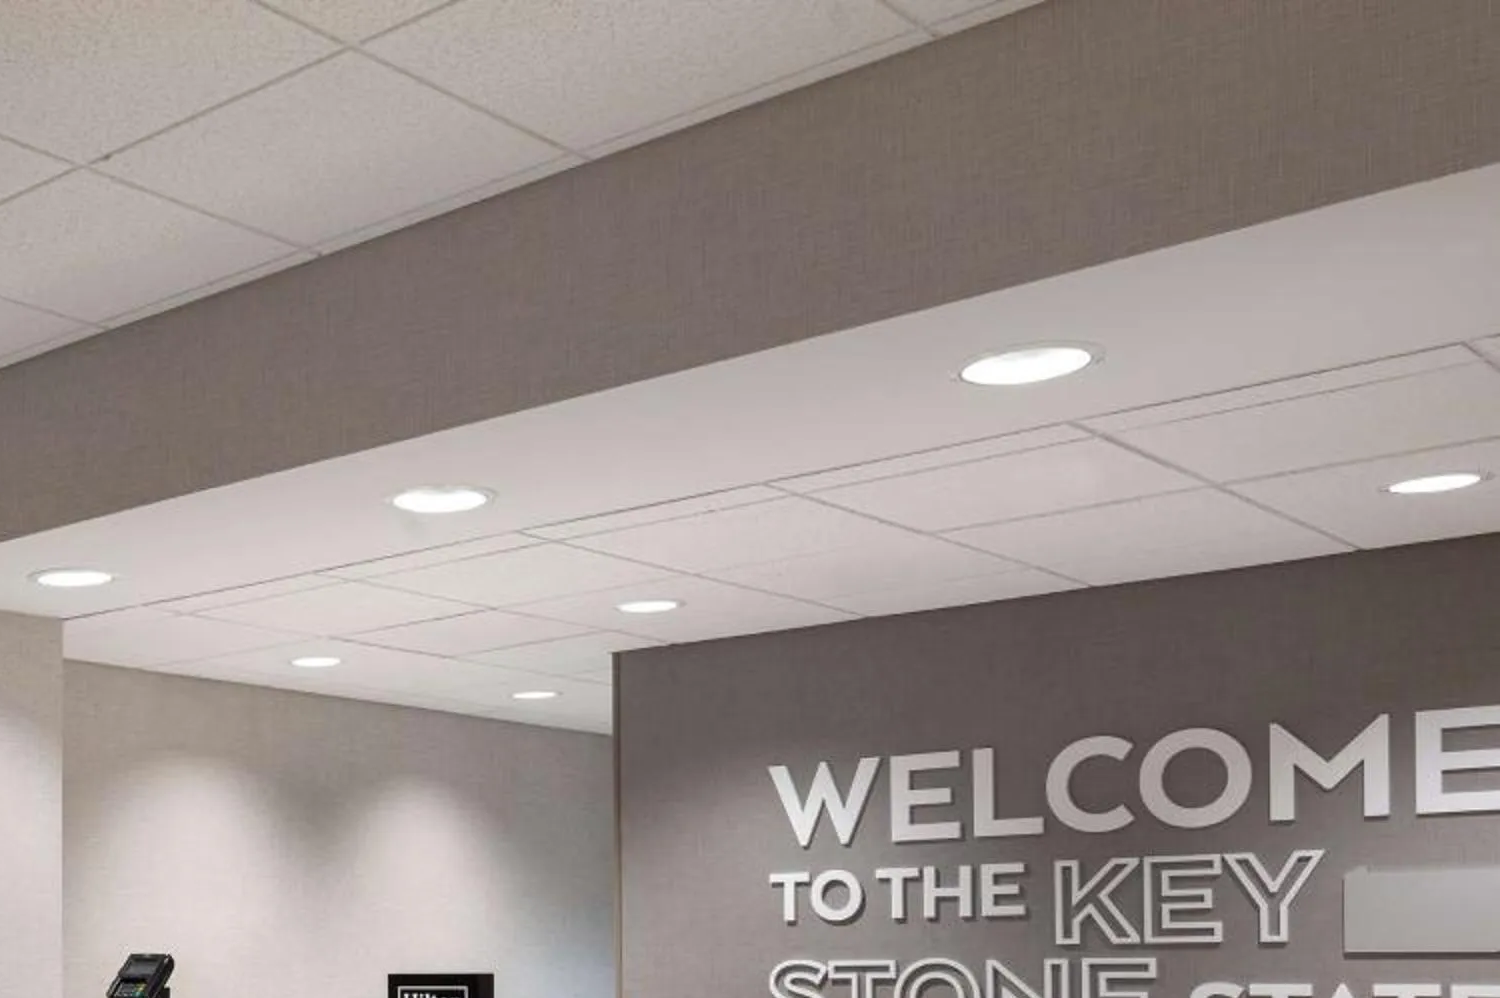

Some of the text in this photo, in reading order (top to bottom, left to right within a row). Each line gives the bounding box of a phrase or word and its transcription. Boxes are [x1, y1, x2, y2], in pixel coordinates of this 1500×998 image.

[767, 705, 1500, 847] WELCOME
[768, 849, 1326, 946] TO THE KEY
